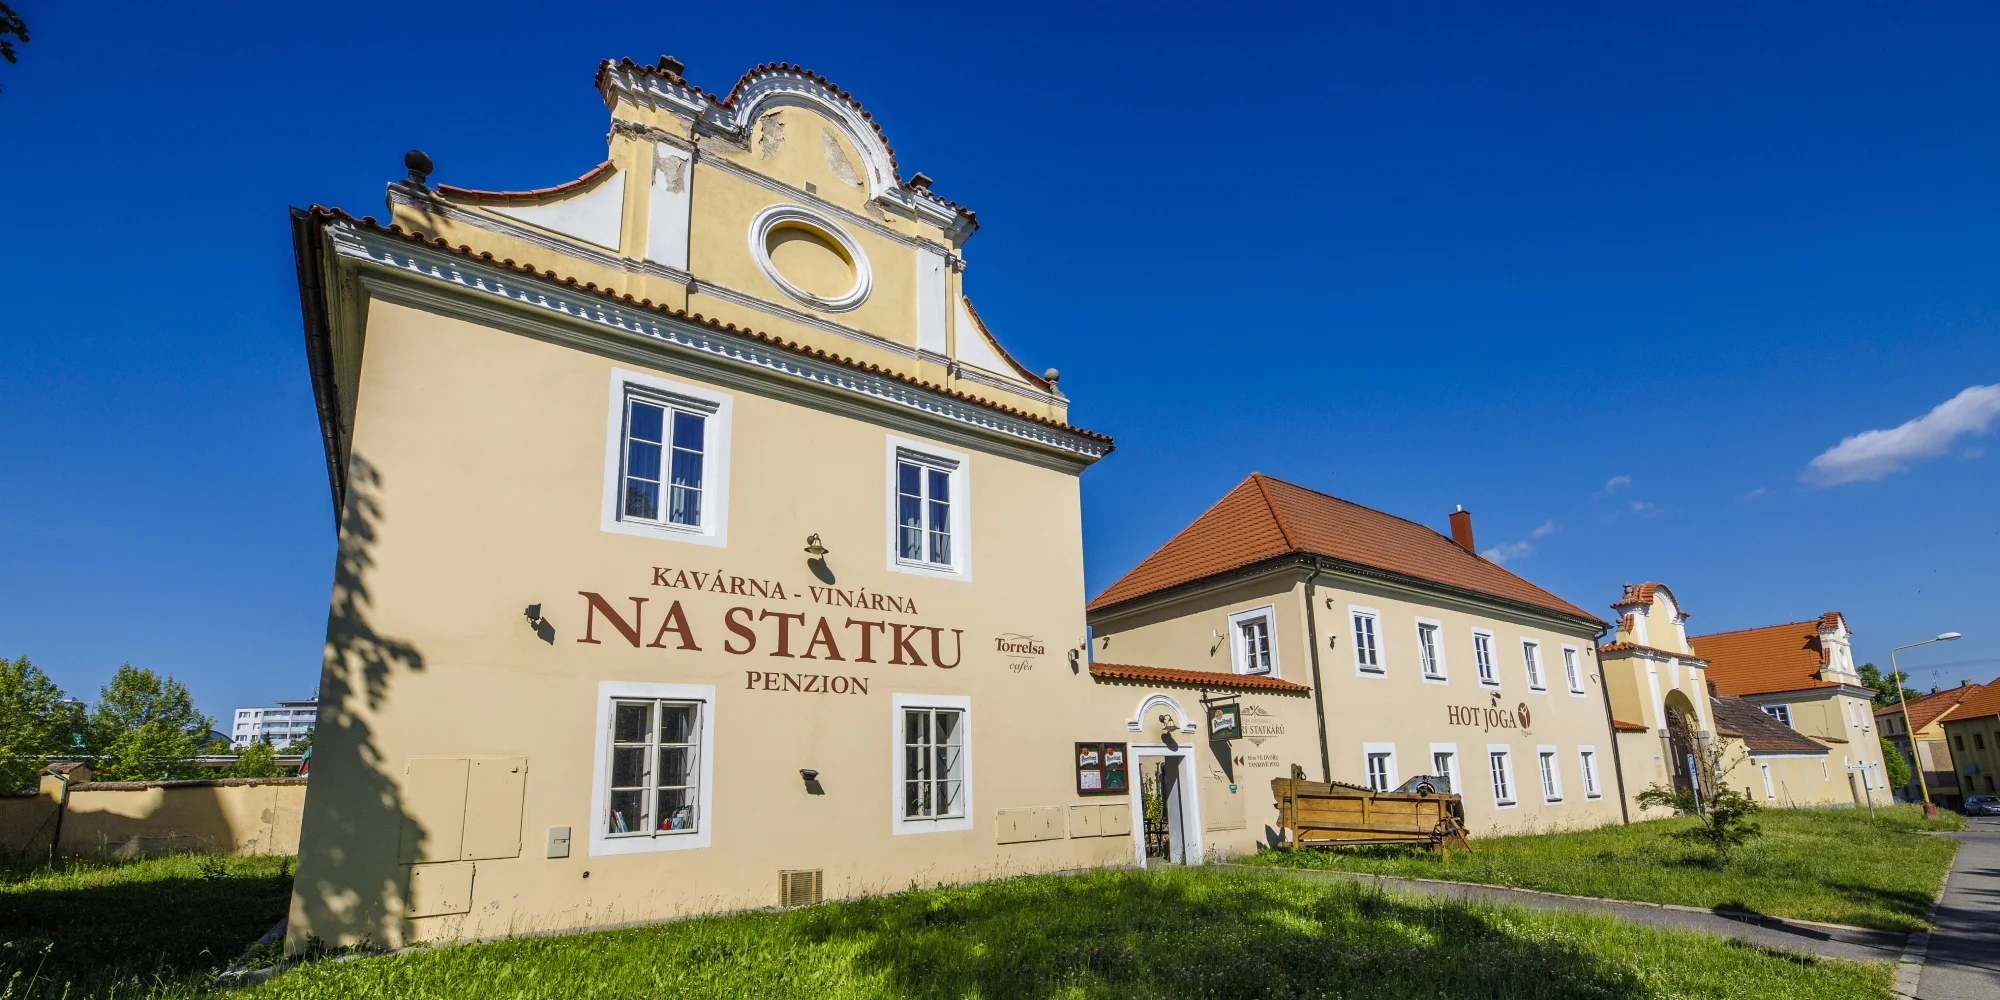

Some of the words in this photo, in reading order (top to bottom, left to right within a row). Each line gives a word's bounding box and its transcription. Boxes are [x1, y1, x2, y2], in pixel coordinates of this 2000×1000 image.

[651, 566, 787, 600] KAVÁRNA
[808, 585, 918, 615] VINÁRNA
[577, 591, 702, 651] NA
[724, 606, 964, 669] STATKU
[994, 637, 1045, 655] Torrelsa
[745, 670, 869, 696] PENZION
[1447, 705, 1480, 727] HOT
